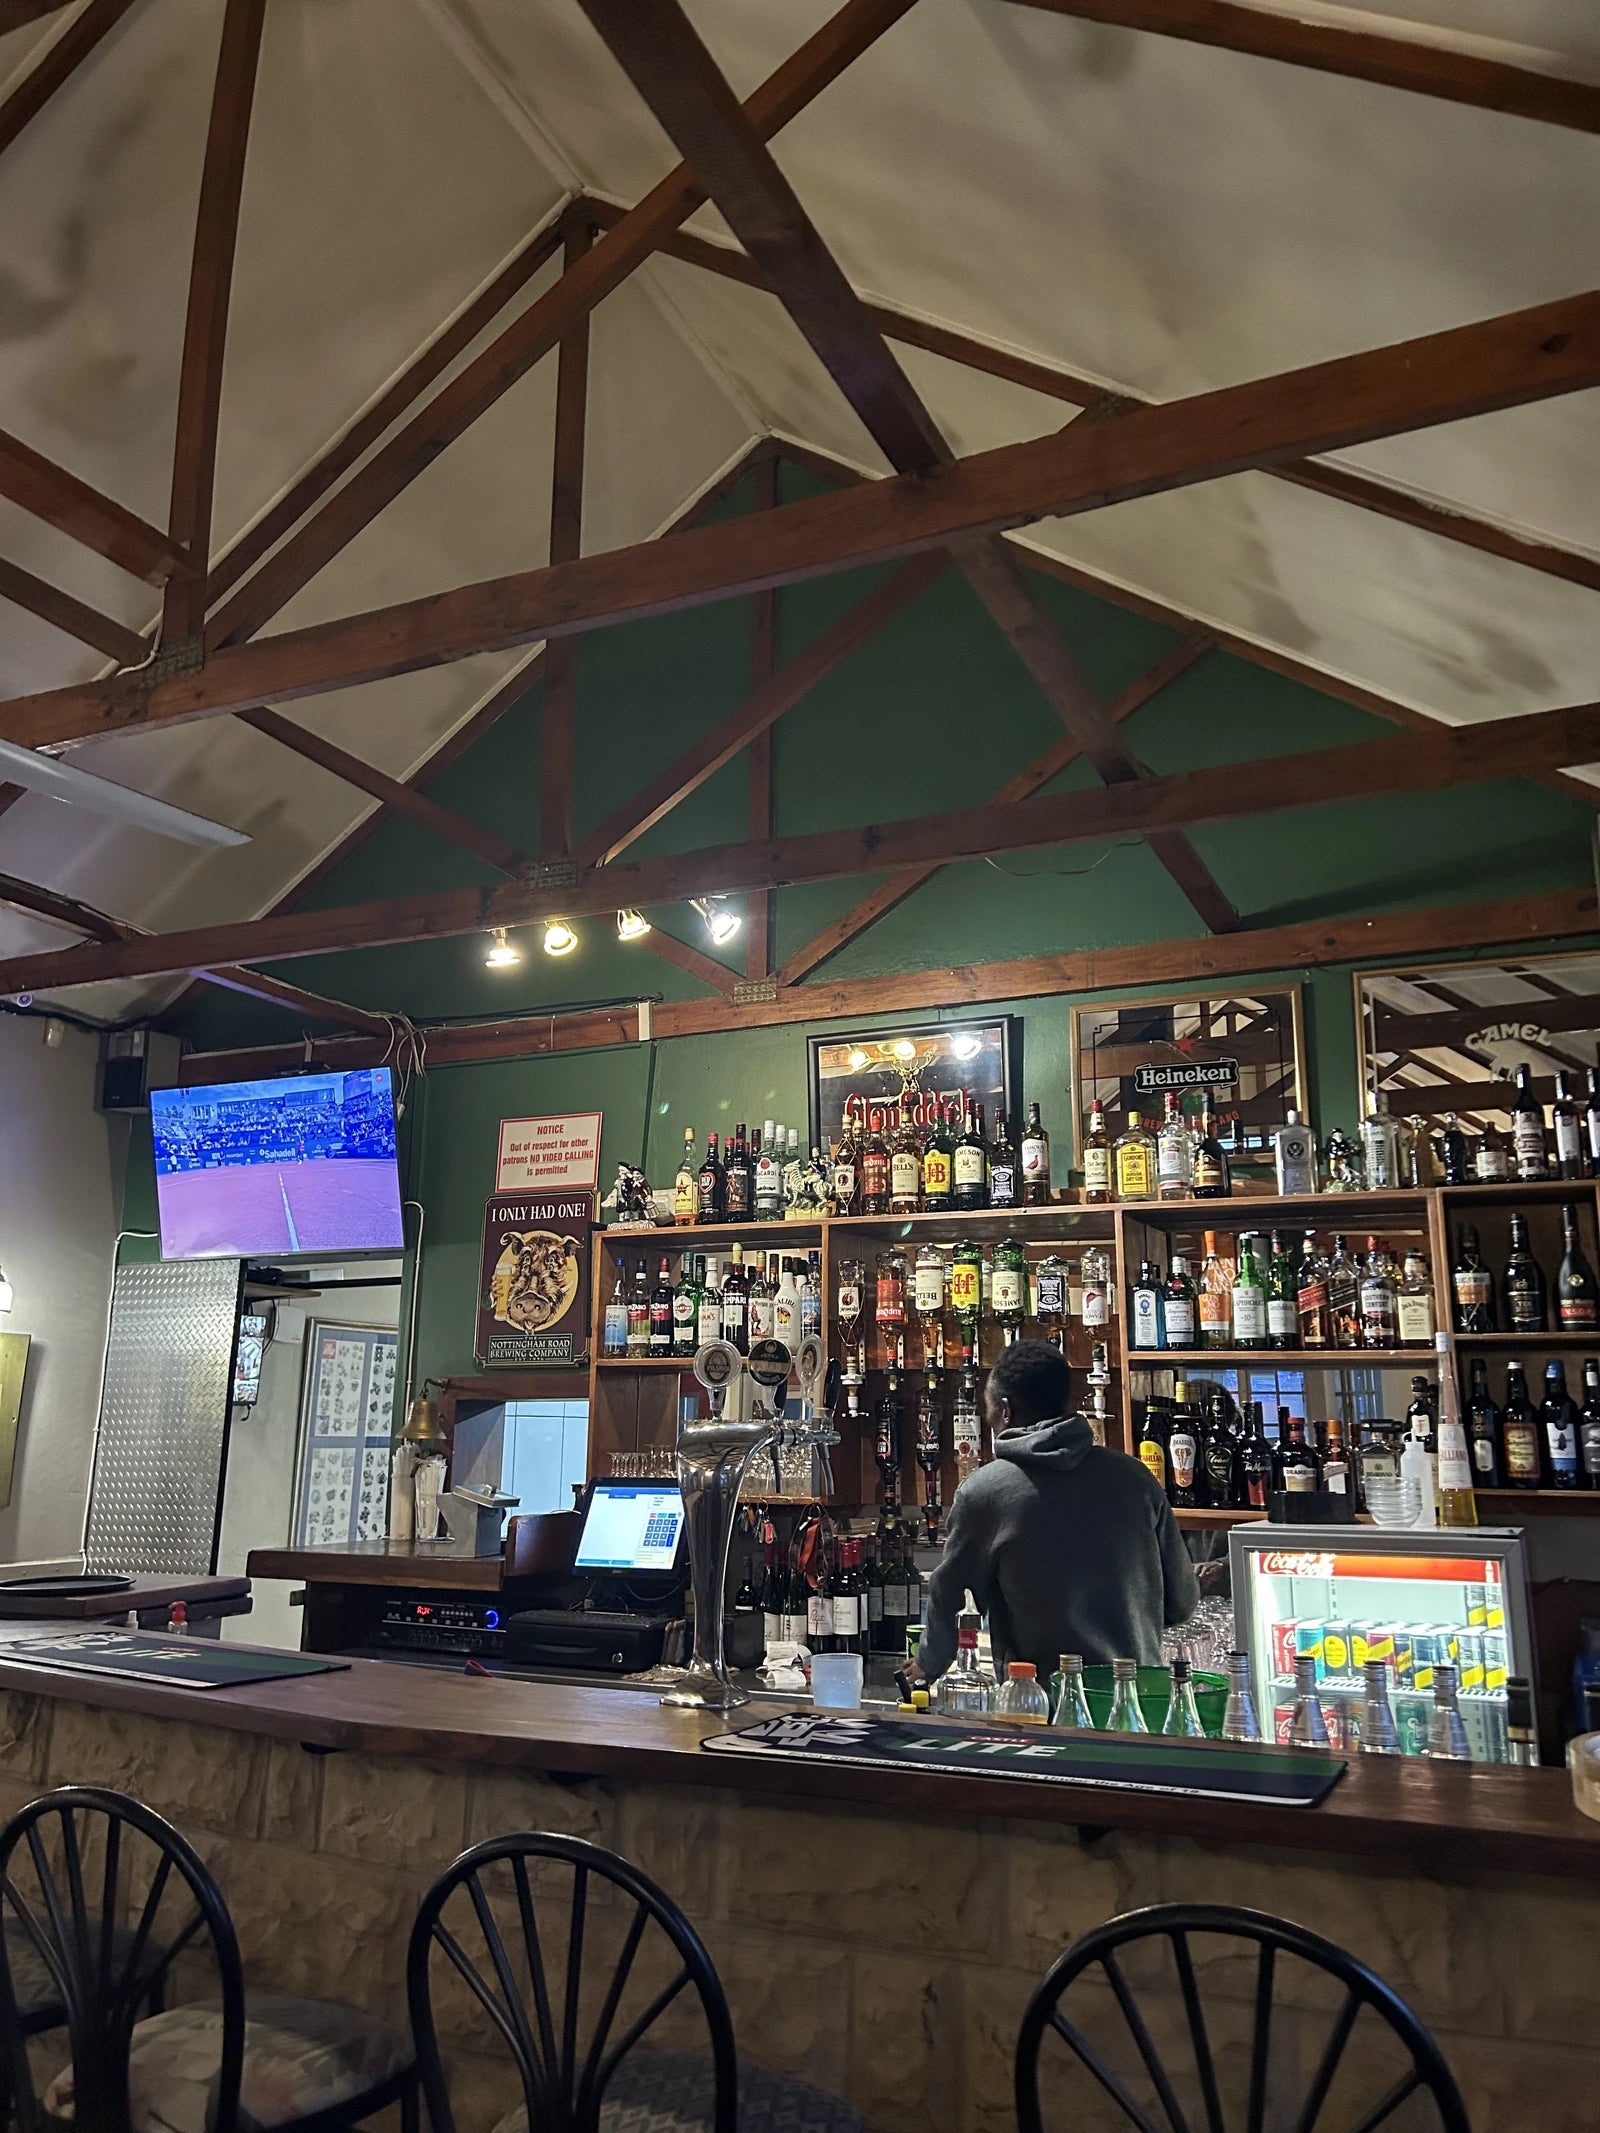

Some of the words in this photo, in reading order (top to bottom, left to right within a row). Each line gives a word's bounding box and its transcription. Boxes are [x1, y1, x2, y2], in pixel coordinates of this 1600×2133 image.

[1465, 1023, 1552, 1050] CAMEL
[1141, 1066, 1232, 1086] Heineken
[537, 1124, 564, 1135] NOTICE
[510, 1143, 522, 1152] Out
[524, 1142, 530, 1150] of
[532, 1140, 558, 1151] respect
[560, 1140, 569, 1148] for
[571, 1138, 588, 1147] other
[502, 1156, 528, 1166] patrons
[530, 1154, 540, 1163] NO
[542, 1152, 562, 1162] VIDEO
[564, 1150, 594, 1160] CALLING
[527, 1168, 533, 1176] is
[535, 1165, 568, 1176] permitted
[492, 1208, 496, 1222] I
[499, 1206, 528, 1222] ONLY
[530, 1204, 555, 1220] HAD
[558, 1202, 586, 1218] ONE!
[490, 1340, 546, 1349] NOTTINGHAM
[548, 1340, 570, 1348] ROAD
[490, 1350, 527, 1358] BREWING
[528, 1349, 569, 1357] COMPANY
[902, 1738, 1067, 1757] LITE
[788, 1751, 825, 1760] Enjoy
[976, 1768, 1039, 1780] Persons
[1044, 1774, 1088, 1784] Under
[1123, 1782, 1155, 1790] Age
